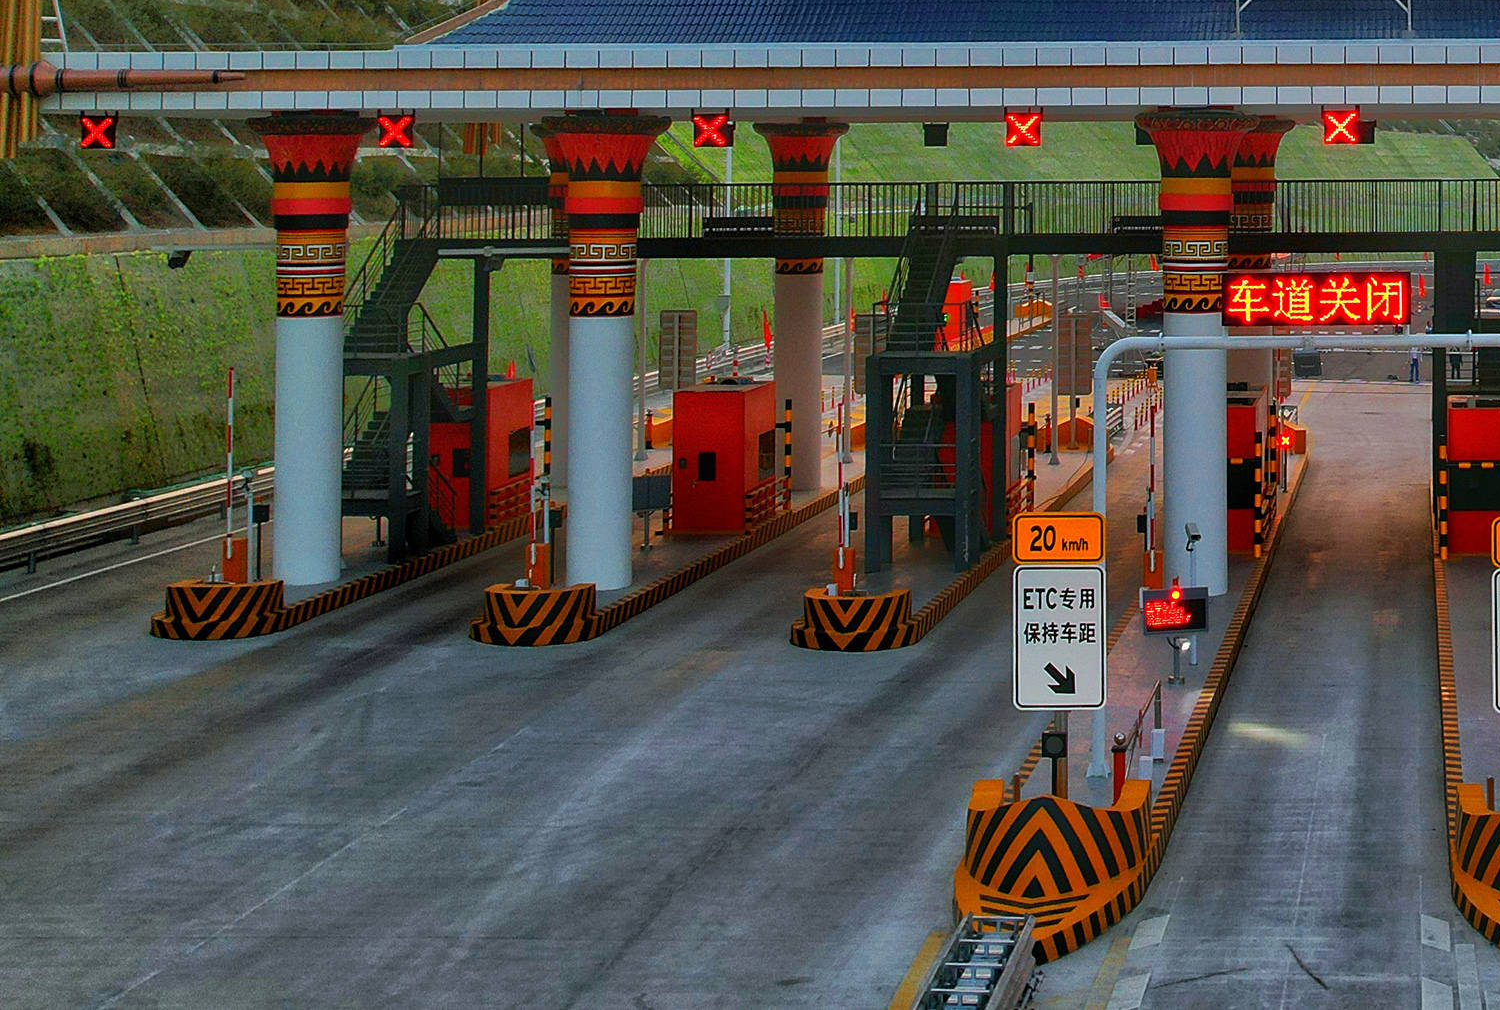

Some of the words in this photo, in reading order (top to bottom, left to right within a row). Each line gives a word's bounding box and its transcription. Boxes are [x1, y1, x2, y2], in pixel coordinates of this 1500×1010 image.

[1228, 277, 1403, 322] 车道关闭
[1030, 525, 1056, 551] 20
[1061, 538, 1089, 551] km/h
[1023, 588, 1095, 610] ETC专用
[1024, 622, 1096, 644] 保持车距
